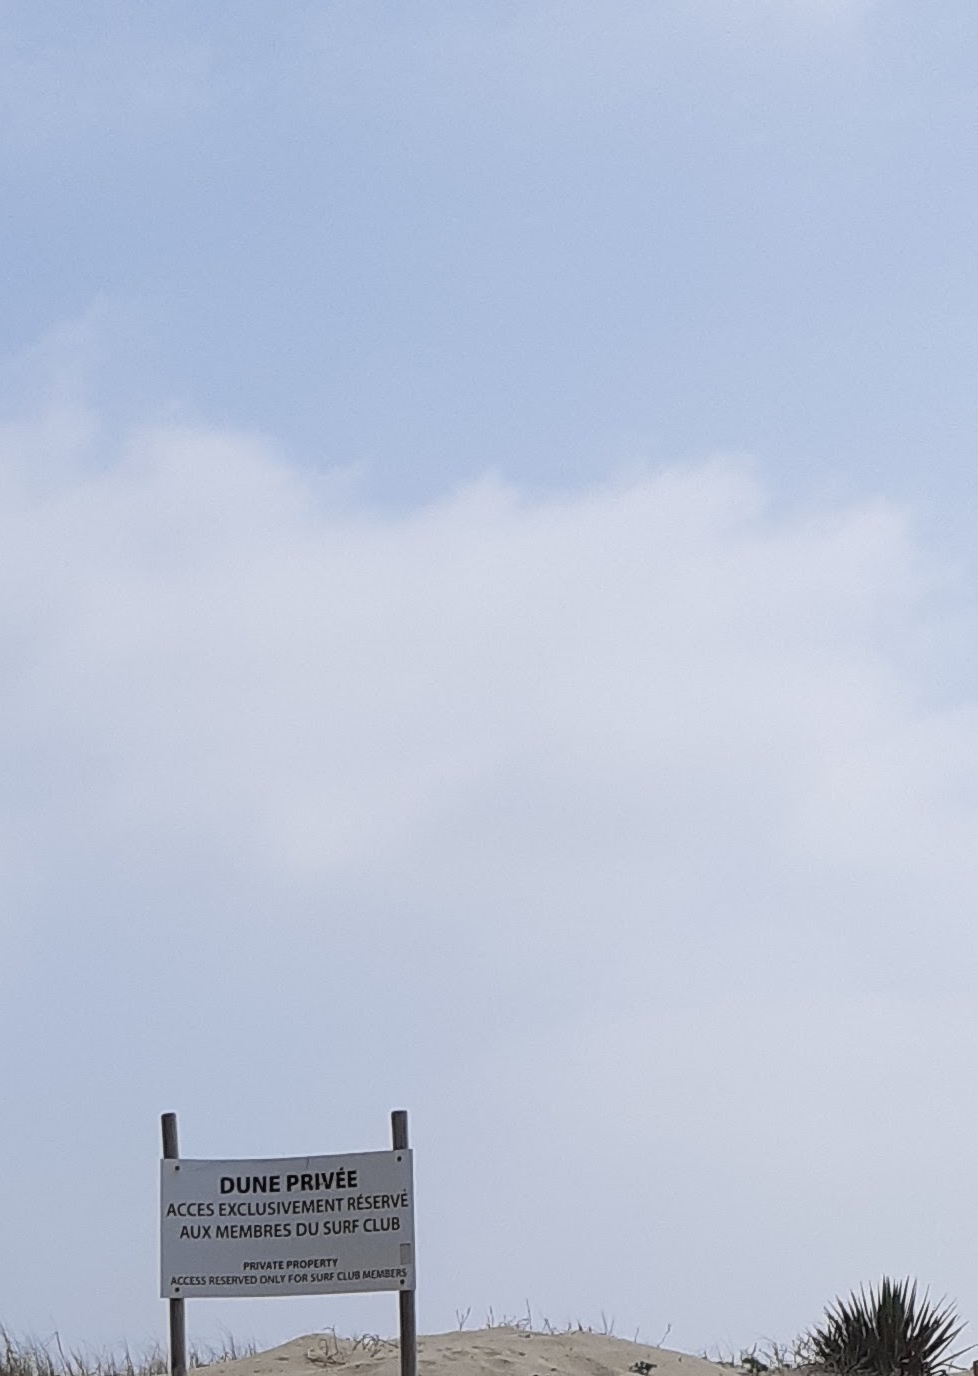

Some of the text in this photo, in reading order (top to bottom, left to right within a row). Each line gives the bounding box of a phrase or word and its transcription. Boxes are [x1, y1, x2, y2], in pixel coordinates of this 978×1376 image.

[220, 1167, 357, 1194] DUNE PRIVÉE
[166, 1189, 408, 1217] ACCES EXCLUSIVEMENT RÉSERVÉ
[180, 1217, 400, 1239] AUX MEMBRES DU SURF CLUB
[243, 1258, 338, 1270] PRIVATE PROPERTY
[171, 1268, 407, 1285] ACCESS RESERVED ONLY FOR SURF CLUB MEMBERS
